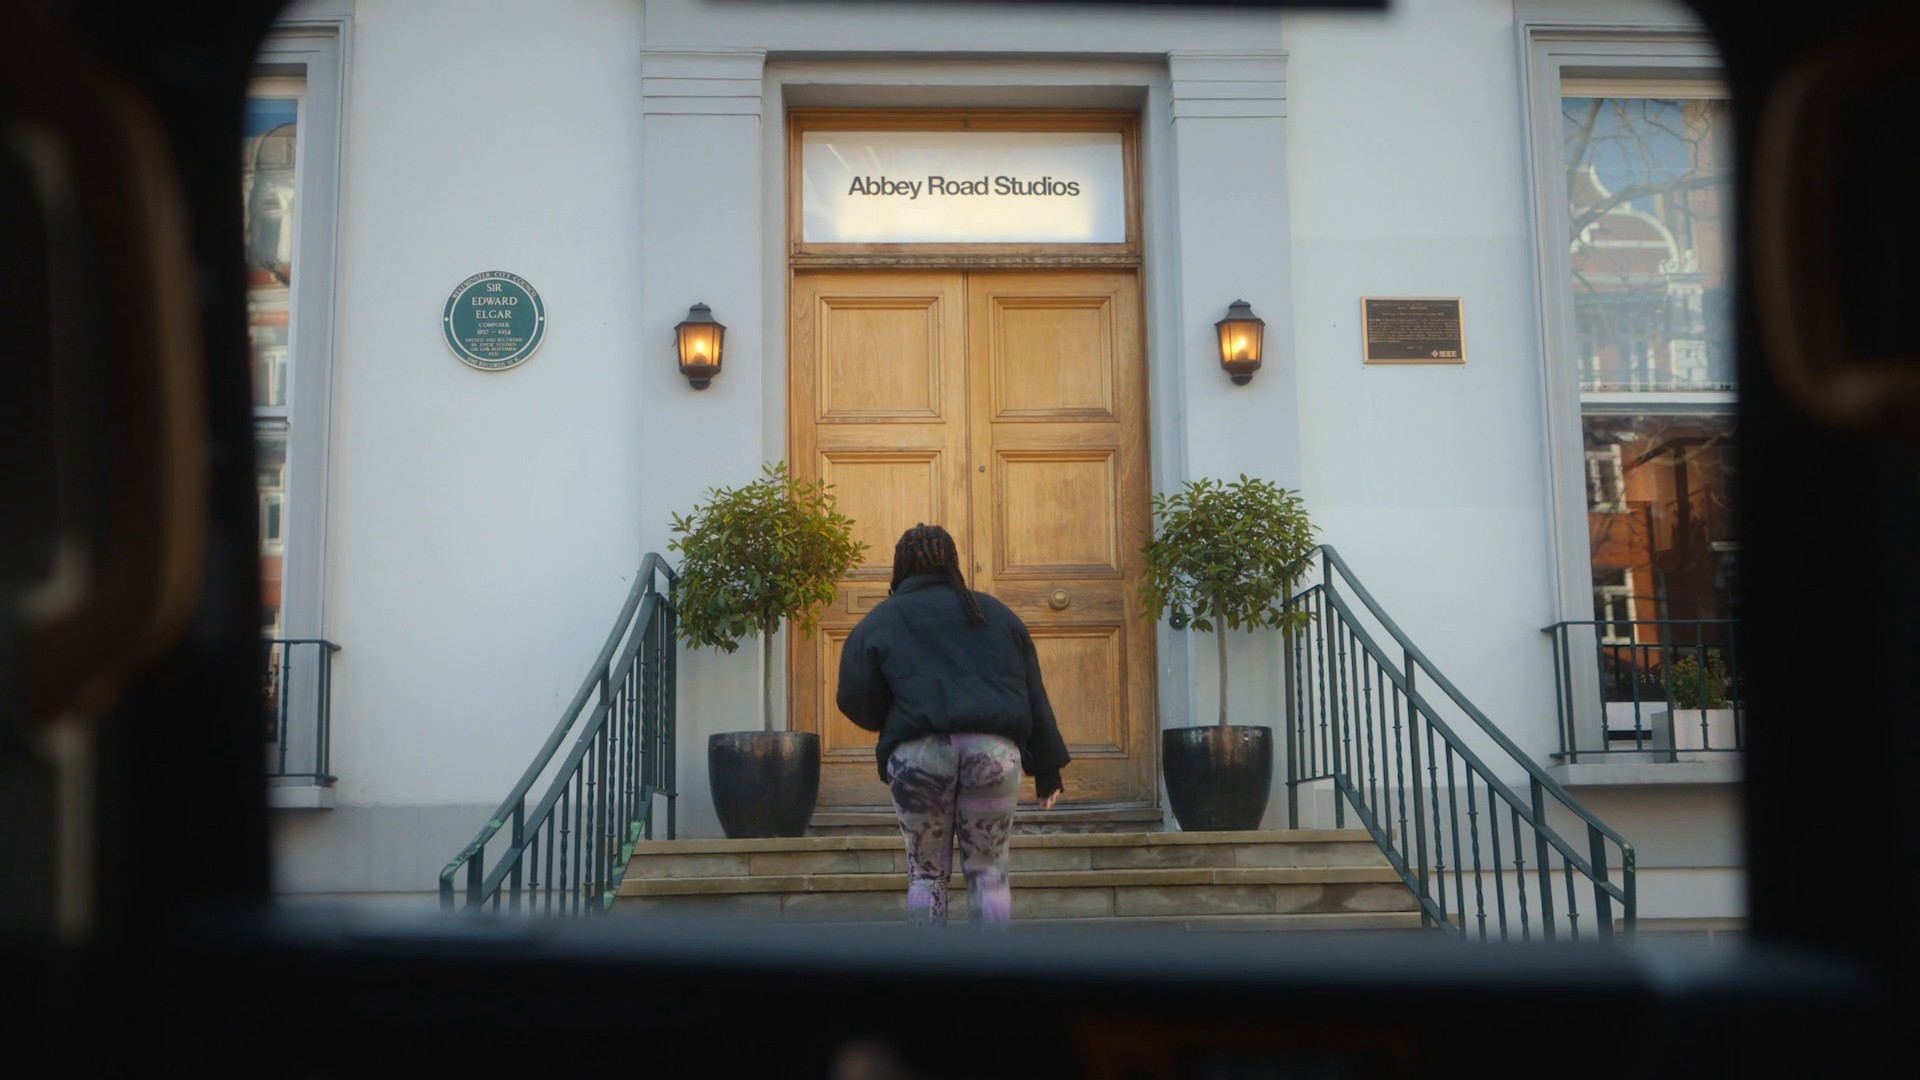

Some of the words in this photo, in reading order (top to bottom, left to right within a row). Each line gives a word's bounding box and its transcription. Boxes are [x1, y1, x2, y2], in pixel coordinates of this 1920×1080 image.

[848, 175, 923, 200] Abbey
[928, 175, 989, 196] Road
[994, 175, 1081, 196] Studios
[451, 272, 491, 299] WESTMINSTER
[494, 271, 510, 279] CITY
[513, 276, 537, 299] COUNCIL
[486, 283, 502, 292] SIR
[471, 296, 518, 306] EDWARD
[475, 310, 512, 319] ELGAR
